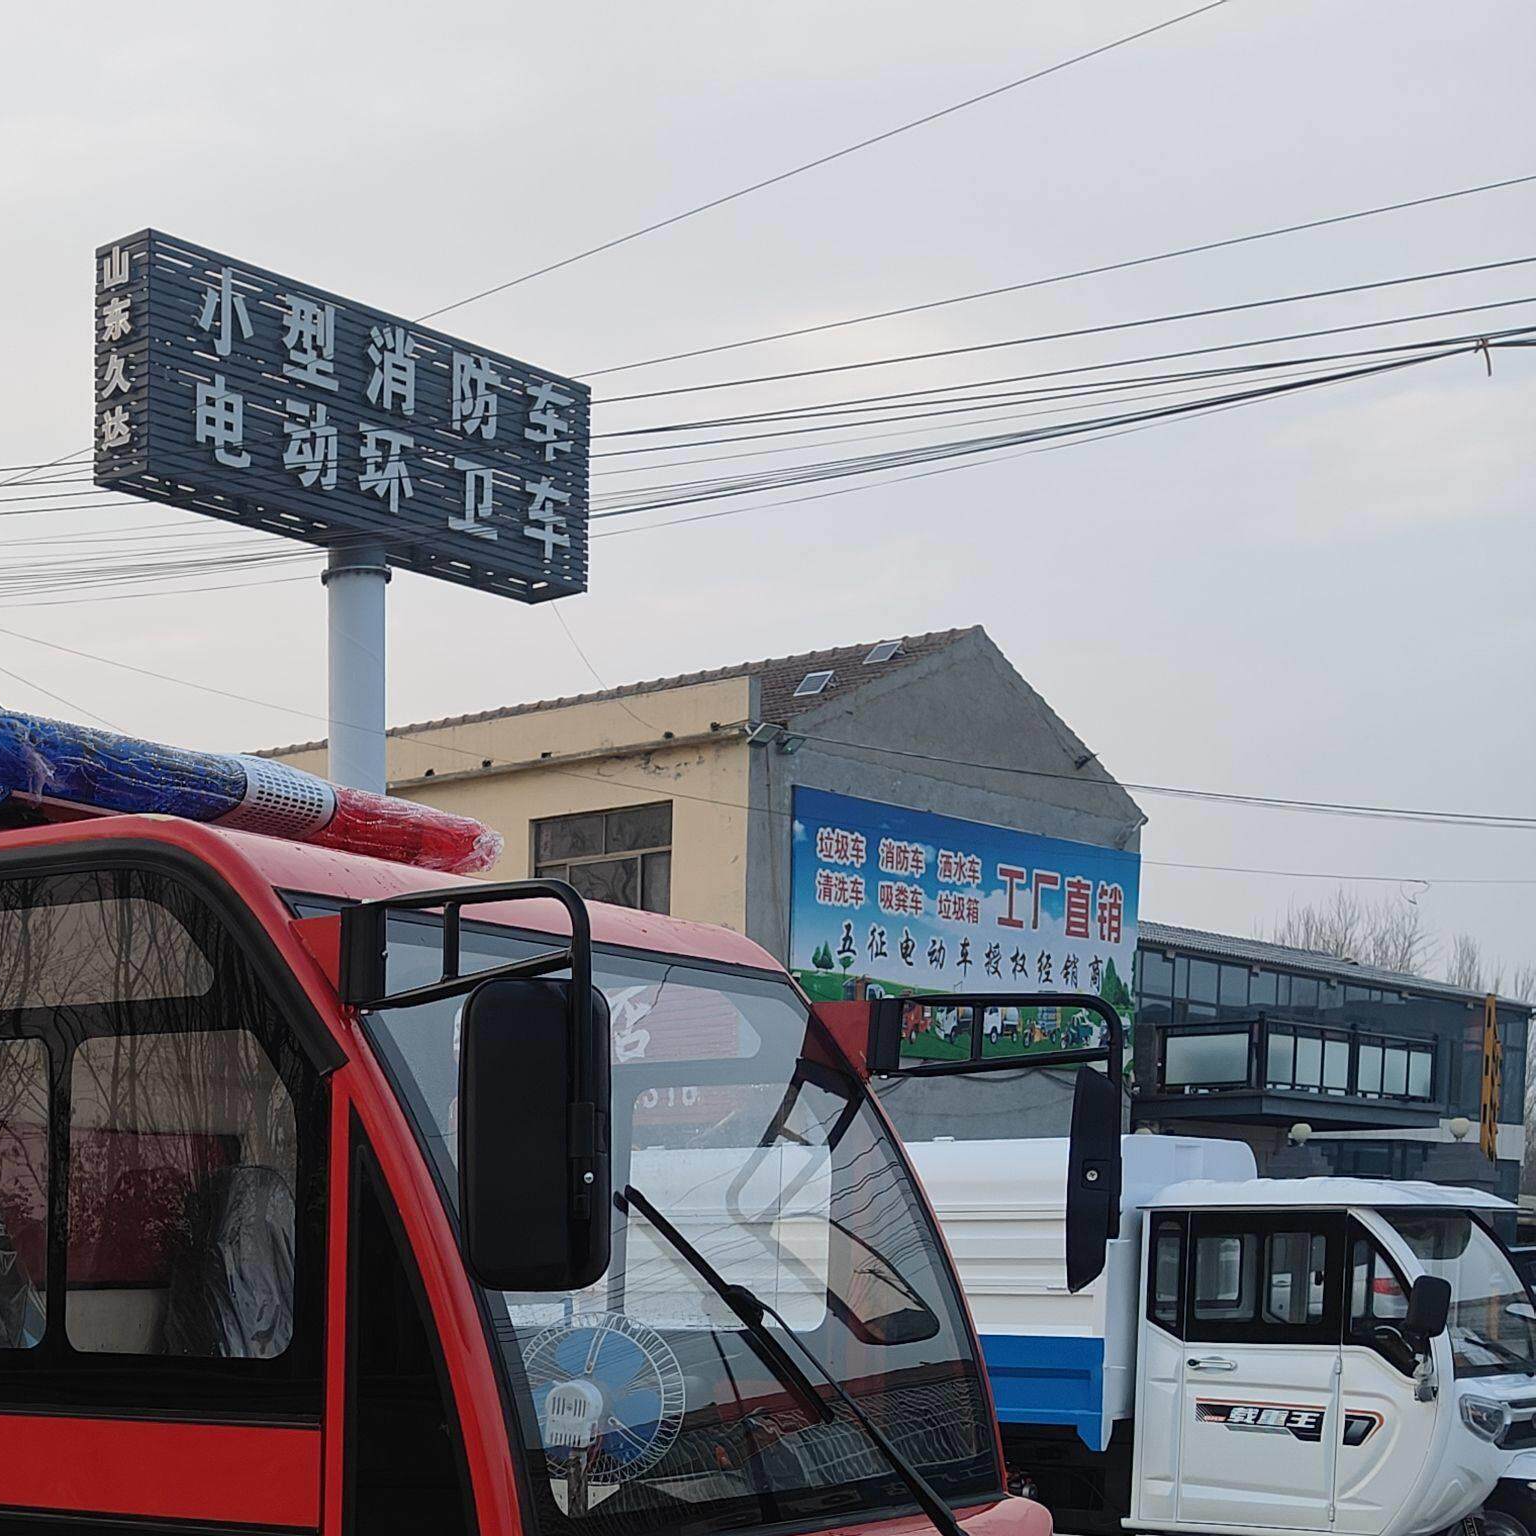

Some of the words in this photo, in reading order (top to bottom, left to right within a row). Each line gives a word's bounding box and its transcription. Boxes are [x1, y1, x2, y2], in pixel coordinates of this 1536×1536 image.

[101, 245, 132, 453] 山东久达
[198, 266, 576, 463] 小型消防车
[194, 374, 573, 561] 电动环卫车
[816, 868, 866, 907] 清洗车
[878, 881, 924, 916] 吸粪车
[937, 891, 981, 925] 垃圾箱
[817, 827, 867, 867] 垃圾车
[878, 839, 926, 877] 消防车
[938, 849, 982, 886] 洒水车
[997, 864, 1124, 944] 工厂直销
[835, 920, 1104, 994] 五征电动车授权经销商
